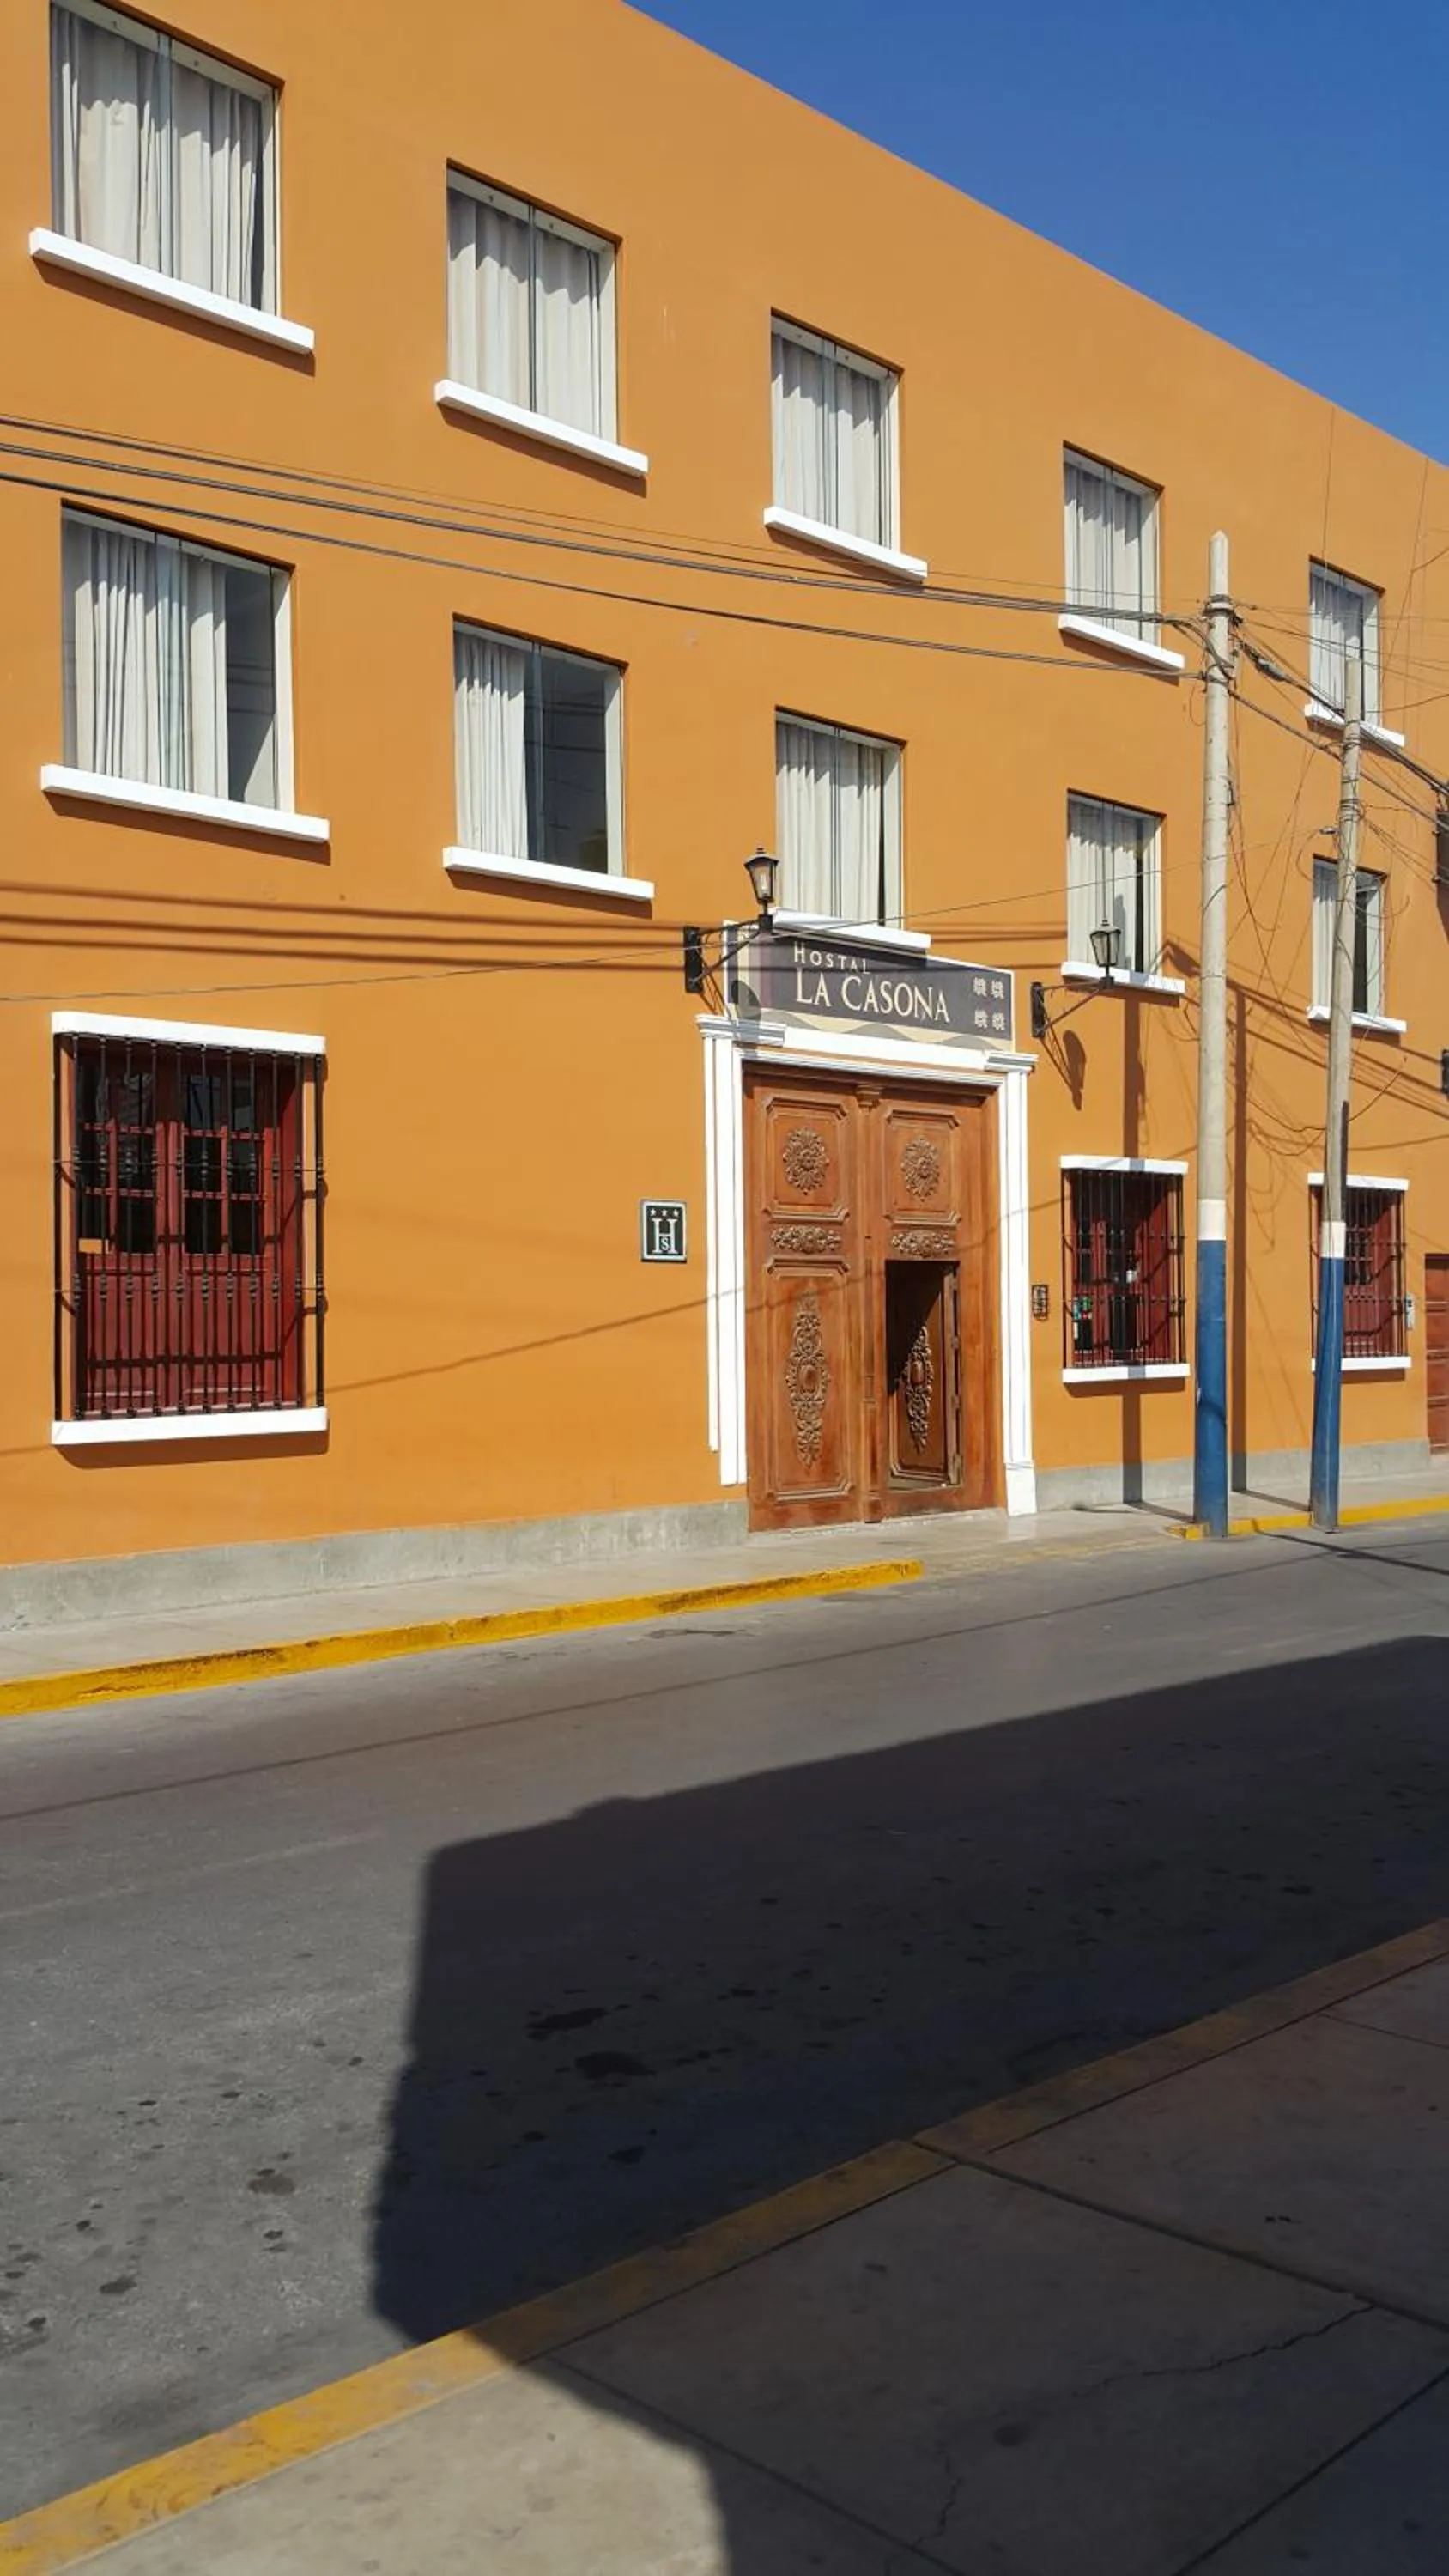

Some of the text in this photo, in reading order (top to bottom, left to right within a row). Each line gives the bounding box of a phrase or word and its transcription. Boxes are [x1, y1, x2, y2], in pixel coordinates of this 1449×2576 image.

[793, 940, 871, 975] HOSTAL
[796, 967, 951, 1024] LA CASONA
